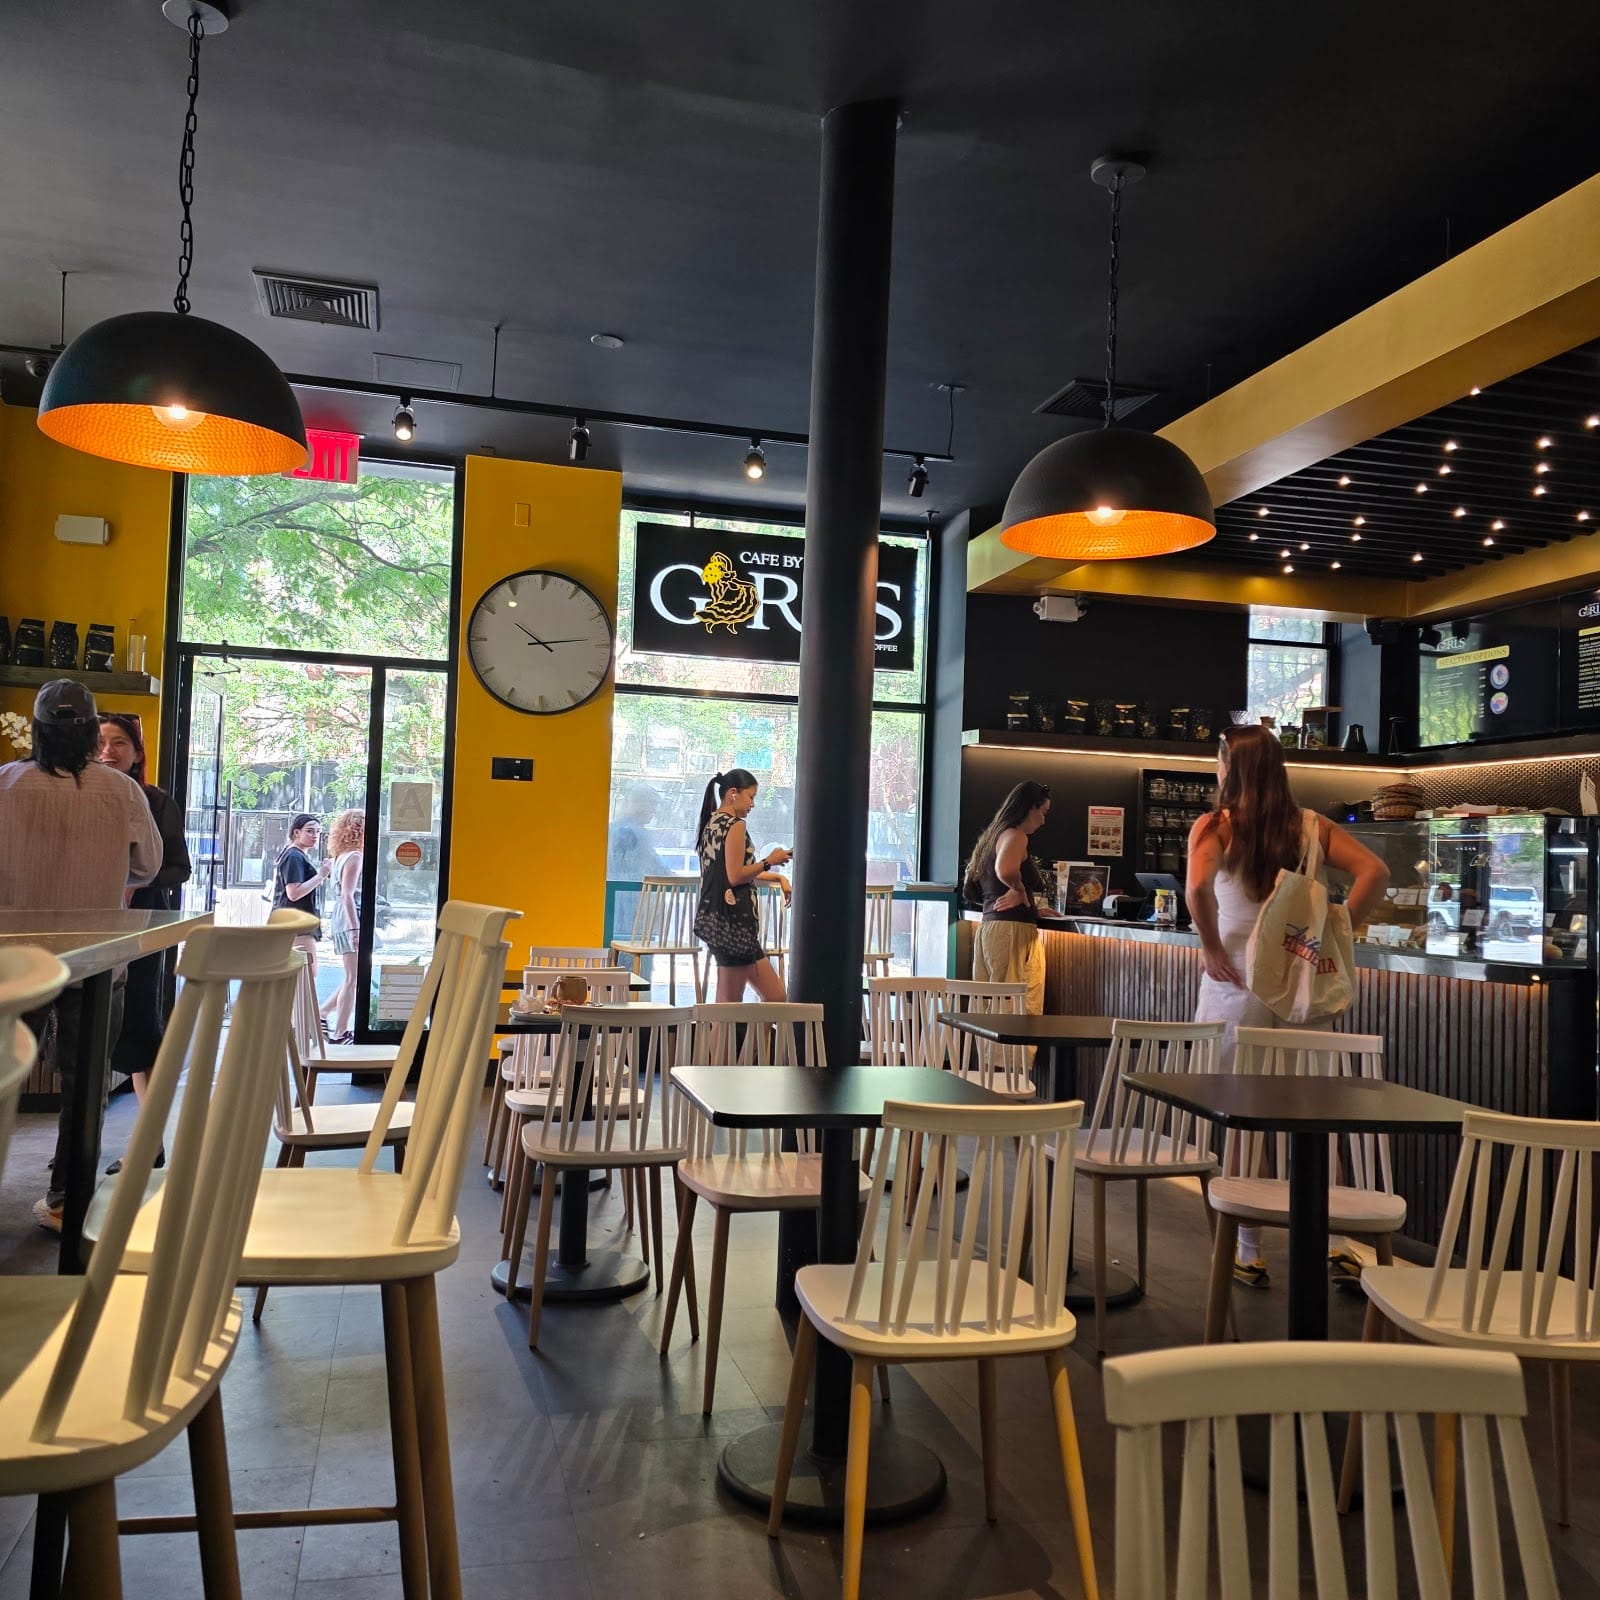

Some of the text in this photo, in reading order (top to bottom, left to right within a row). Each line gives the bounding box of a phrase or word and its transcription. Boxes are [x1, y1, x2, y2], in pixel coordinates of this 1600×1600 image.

[292, 434, 353, 481] XIT
[739, 551, 804, 568] CAFE BY
[874, 643, 898, 652] OFFEE
[1438, 647, 1507, 667] HEALTHY OPTIONS
[397, 788, 426, 818] A
